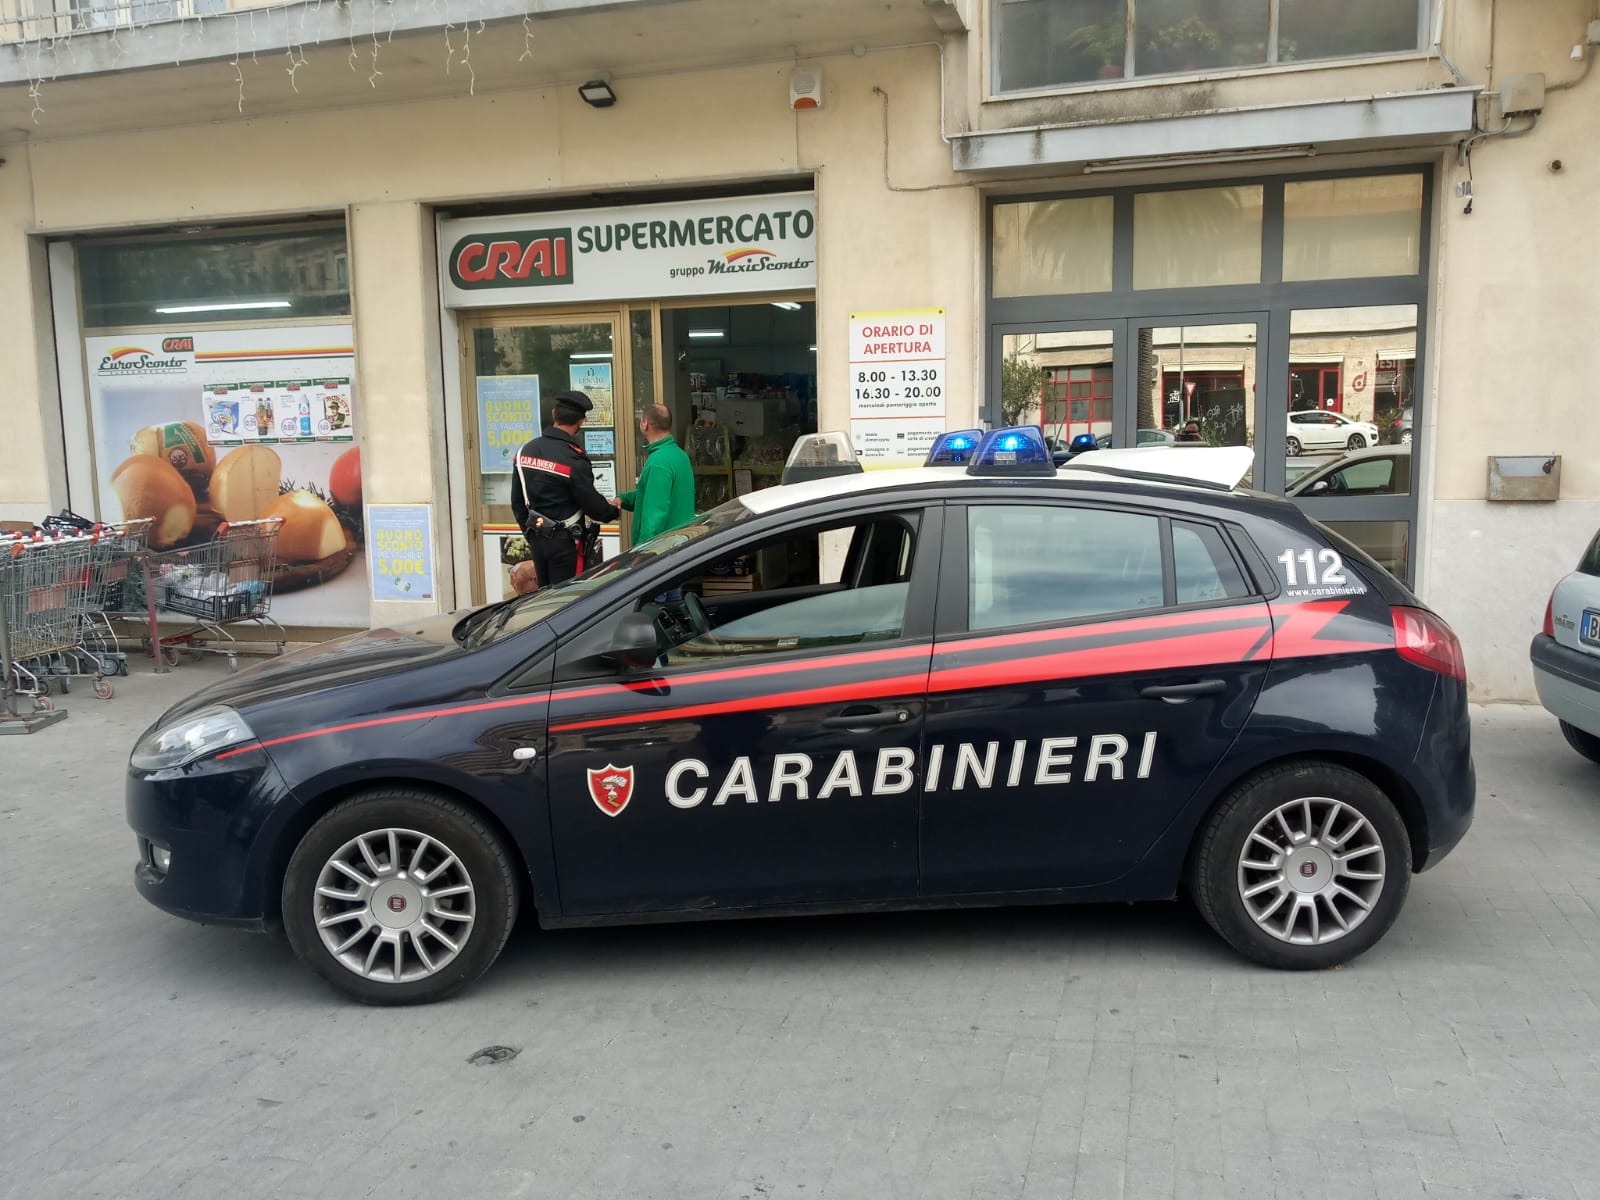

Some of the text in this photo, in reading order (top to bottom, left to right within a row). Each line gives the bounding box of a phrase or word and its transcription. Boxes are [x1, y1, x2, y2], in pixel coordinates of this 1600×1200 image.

[577, 209, 814, 254] SUPERMERCATO
[457, 237, 567, 282] CRAI
[670, 257, 814, 279] gruppo MaxiSconto
[862, 324, 933, 338] ORARIO DI
[163, 338, 193, 351] CRAI
[863, 341, 932, 354] APERTURA
[99, 355, 187, 370] EuroSconto
[858, 371, 886, 383] 8.00
[901, 369, 937, 382] 13.30
[855, 387, 890, 399] 16.30
[904, 386, 941, 398] 20.00
[486, 400, 531, 411] BUONO
[486, 411, 532, 422] SCONTO
[486, 429, 534, 448] 5,00€
[377, 529, 422, 540] BUONO
[377, 541, 423, 552] SCONTO
[378, 559, 425, 576] 5,00€
[1278, 548, 1347, 585] 112
[1286, 586, 1365, 597] www.carabinieri.it
[665, 731, 1157, 809] CARABINIERI
